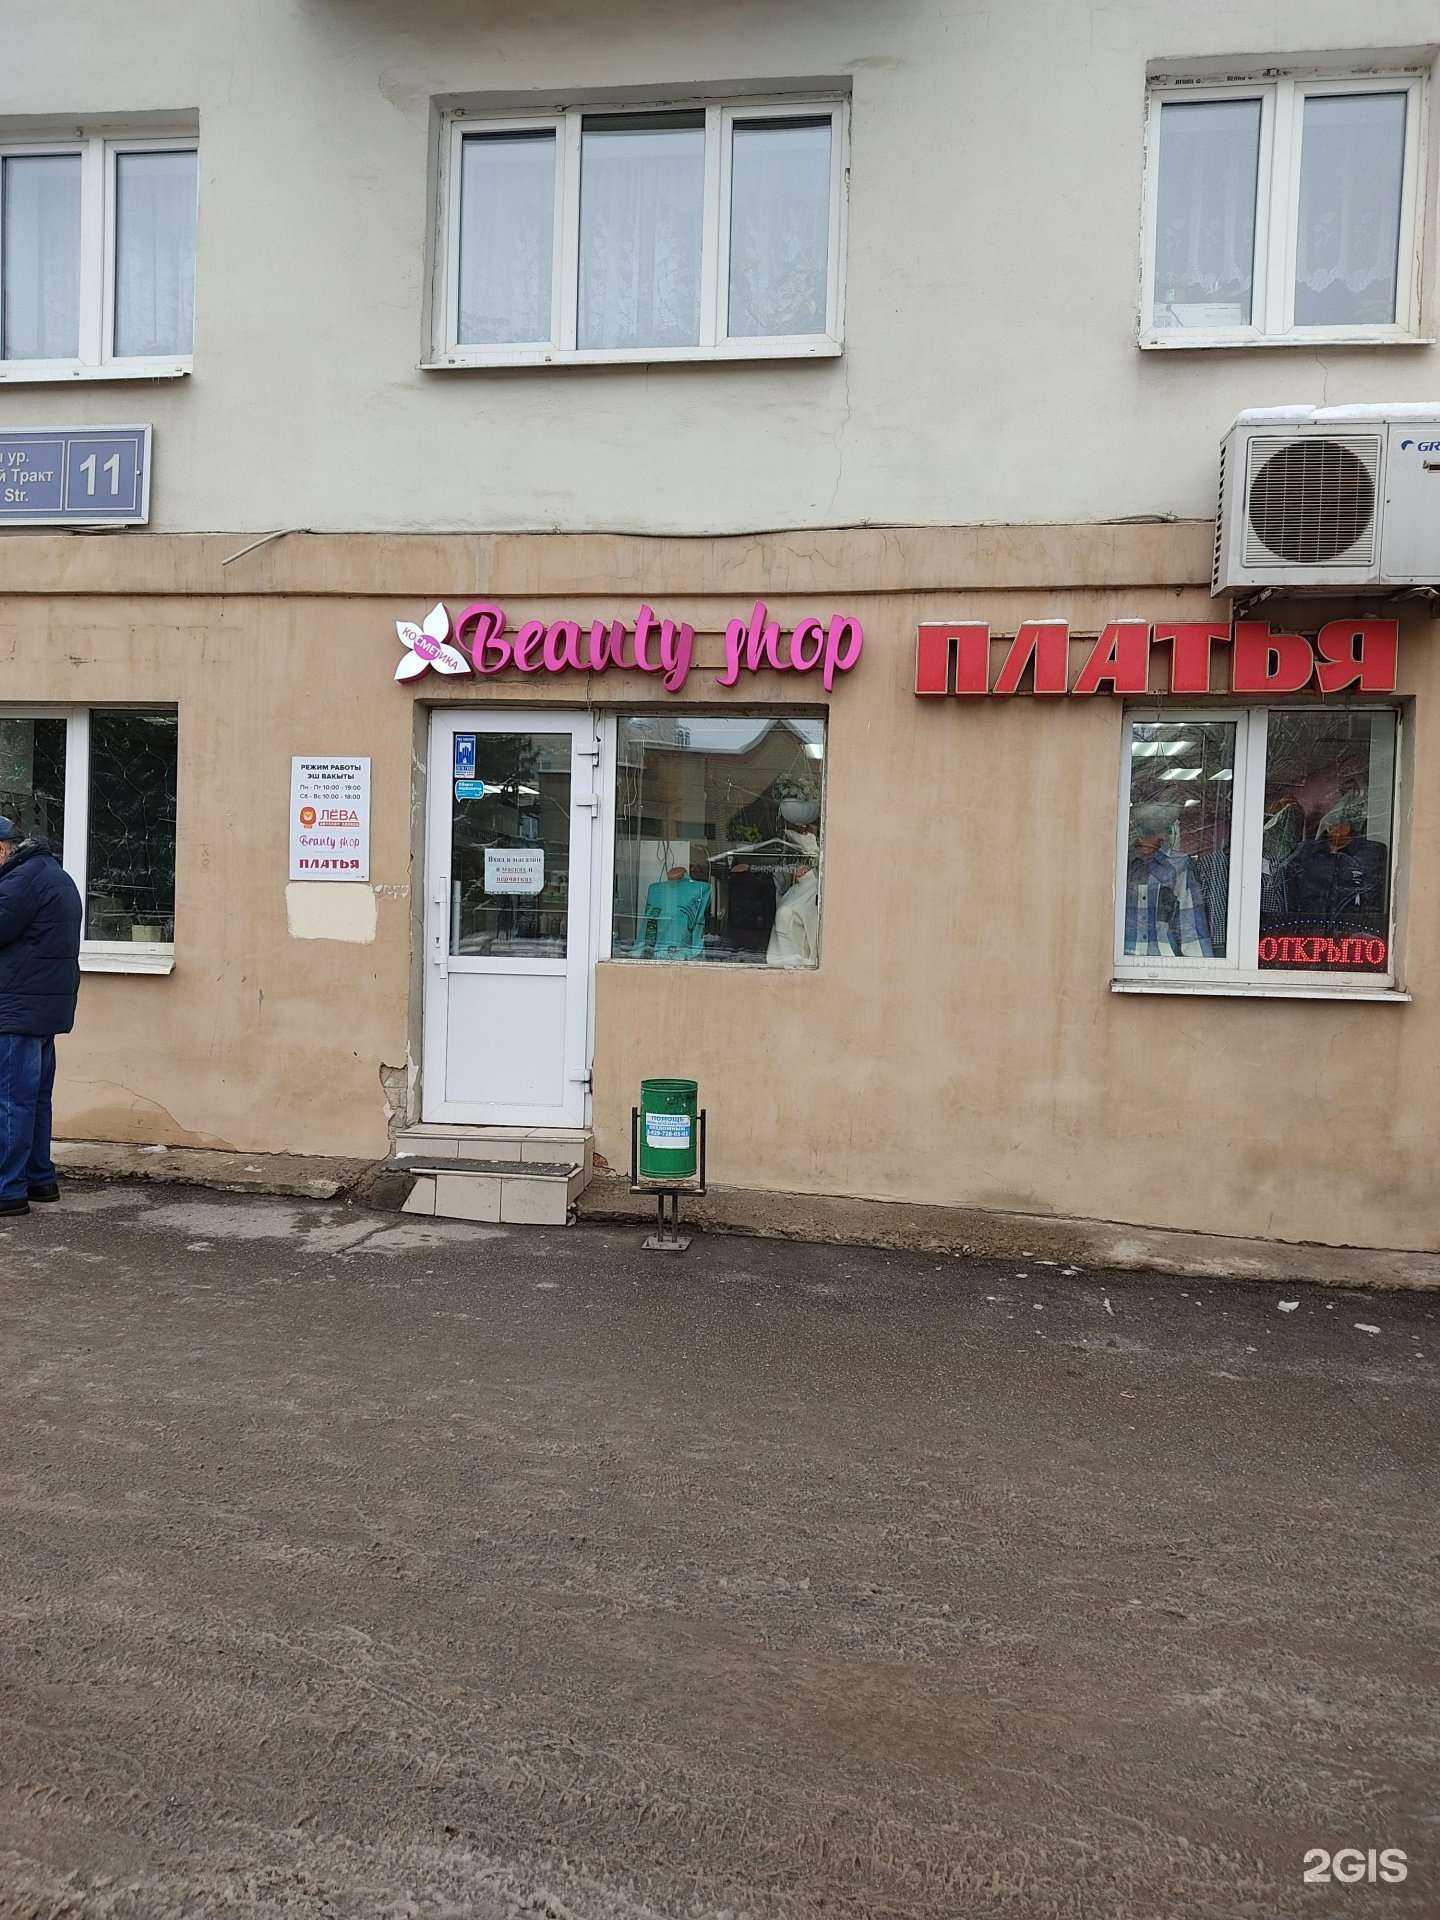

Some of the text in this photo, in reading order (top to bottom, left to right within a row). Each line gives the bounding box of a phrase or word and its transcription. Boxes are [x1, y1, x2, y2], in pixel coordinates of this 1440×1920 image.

[7, 451, 30, 466] ур.
[10, 468, 54, 485] Тракт
[79, 453, 120, 496] 11
[4, 487, 29, 502] Str.
[402, 626, 459, 671] КОСМЕТИКА
[455, 600, 866, 694] Beauty shop
[914, 617, 1400, 696] ПЛАТЬЯ
[320, 808, 359, 821] ЛЁВА
[298, 834, 336, 849] Beauty
[299, 858, 360, 869] ПЛАТЬЯ
[1260, 937, 1386, 964] ОТКРЫТО
